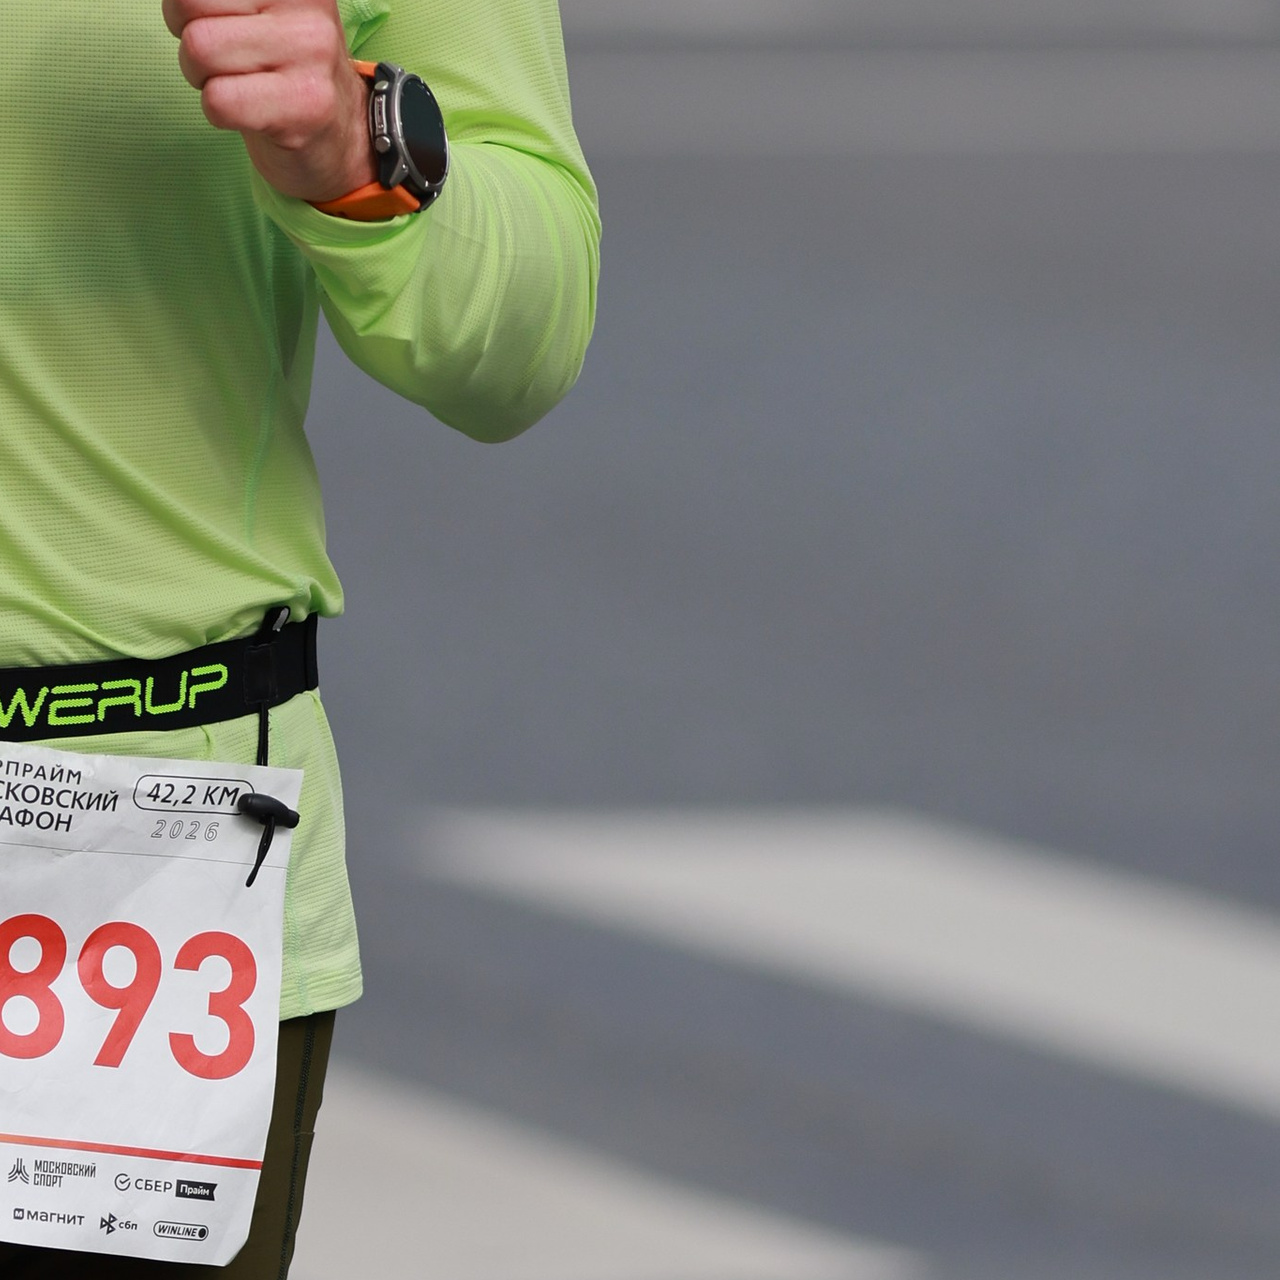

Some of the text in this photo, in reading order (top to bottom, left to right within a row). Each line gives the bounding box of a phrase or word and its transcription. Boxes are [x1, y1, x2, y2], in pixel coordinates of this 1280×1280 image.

[147, 783, 196, 807] 42,2
[151, 819, 220, 842] 2026
[34, 1160, 96, 1178] МОСКОВСКИЙ
[33, 1173, 63, 1188] СПОРТ
[135, 1179, 210, 1196] СБЕР Прайм
[158, 1224, 197, 1237] WINLINE
